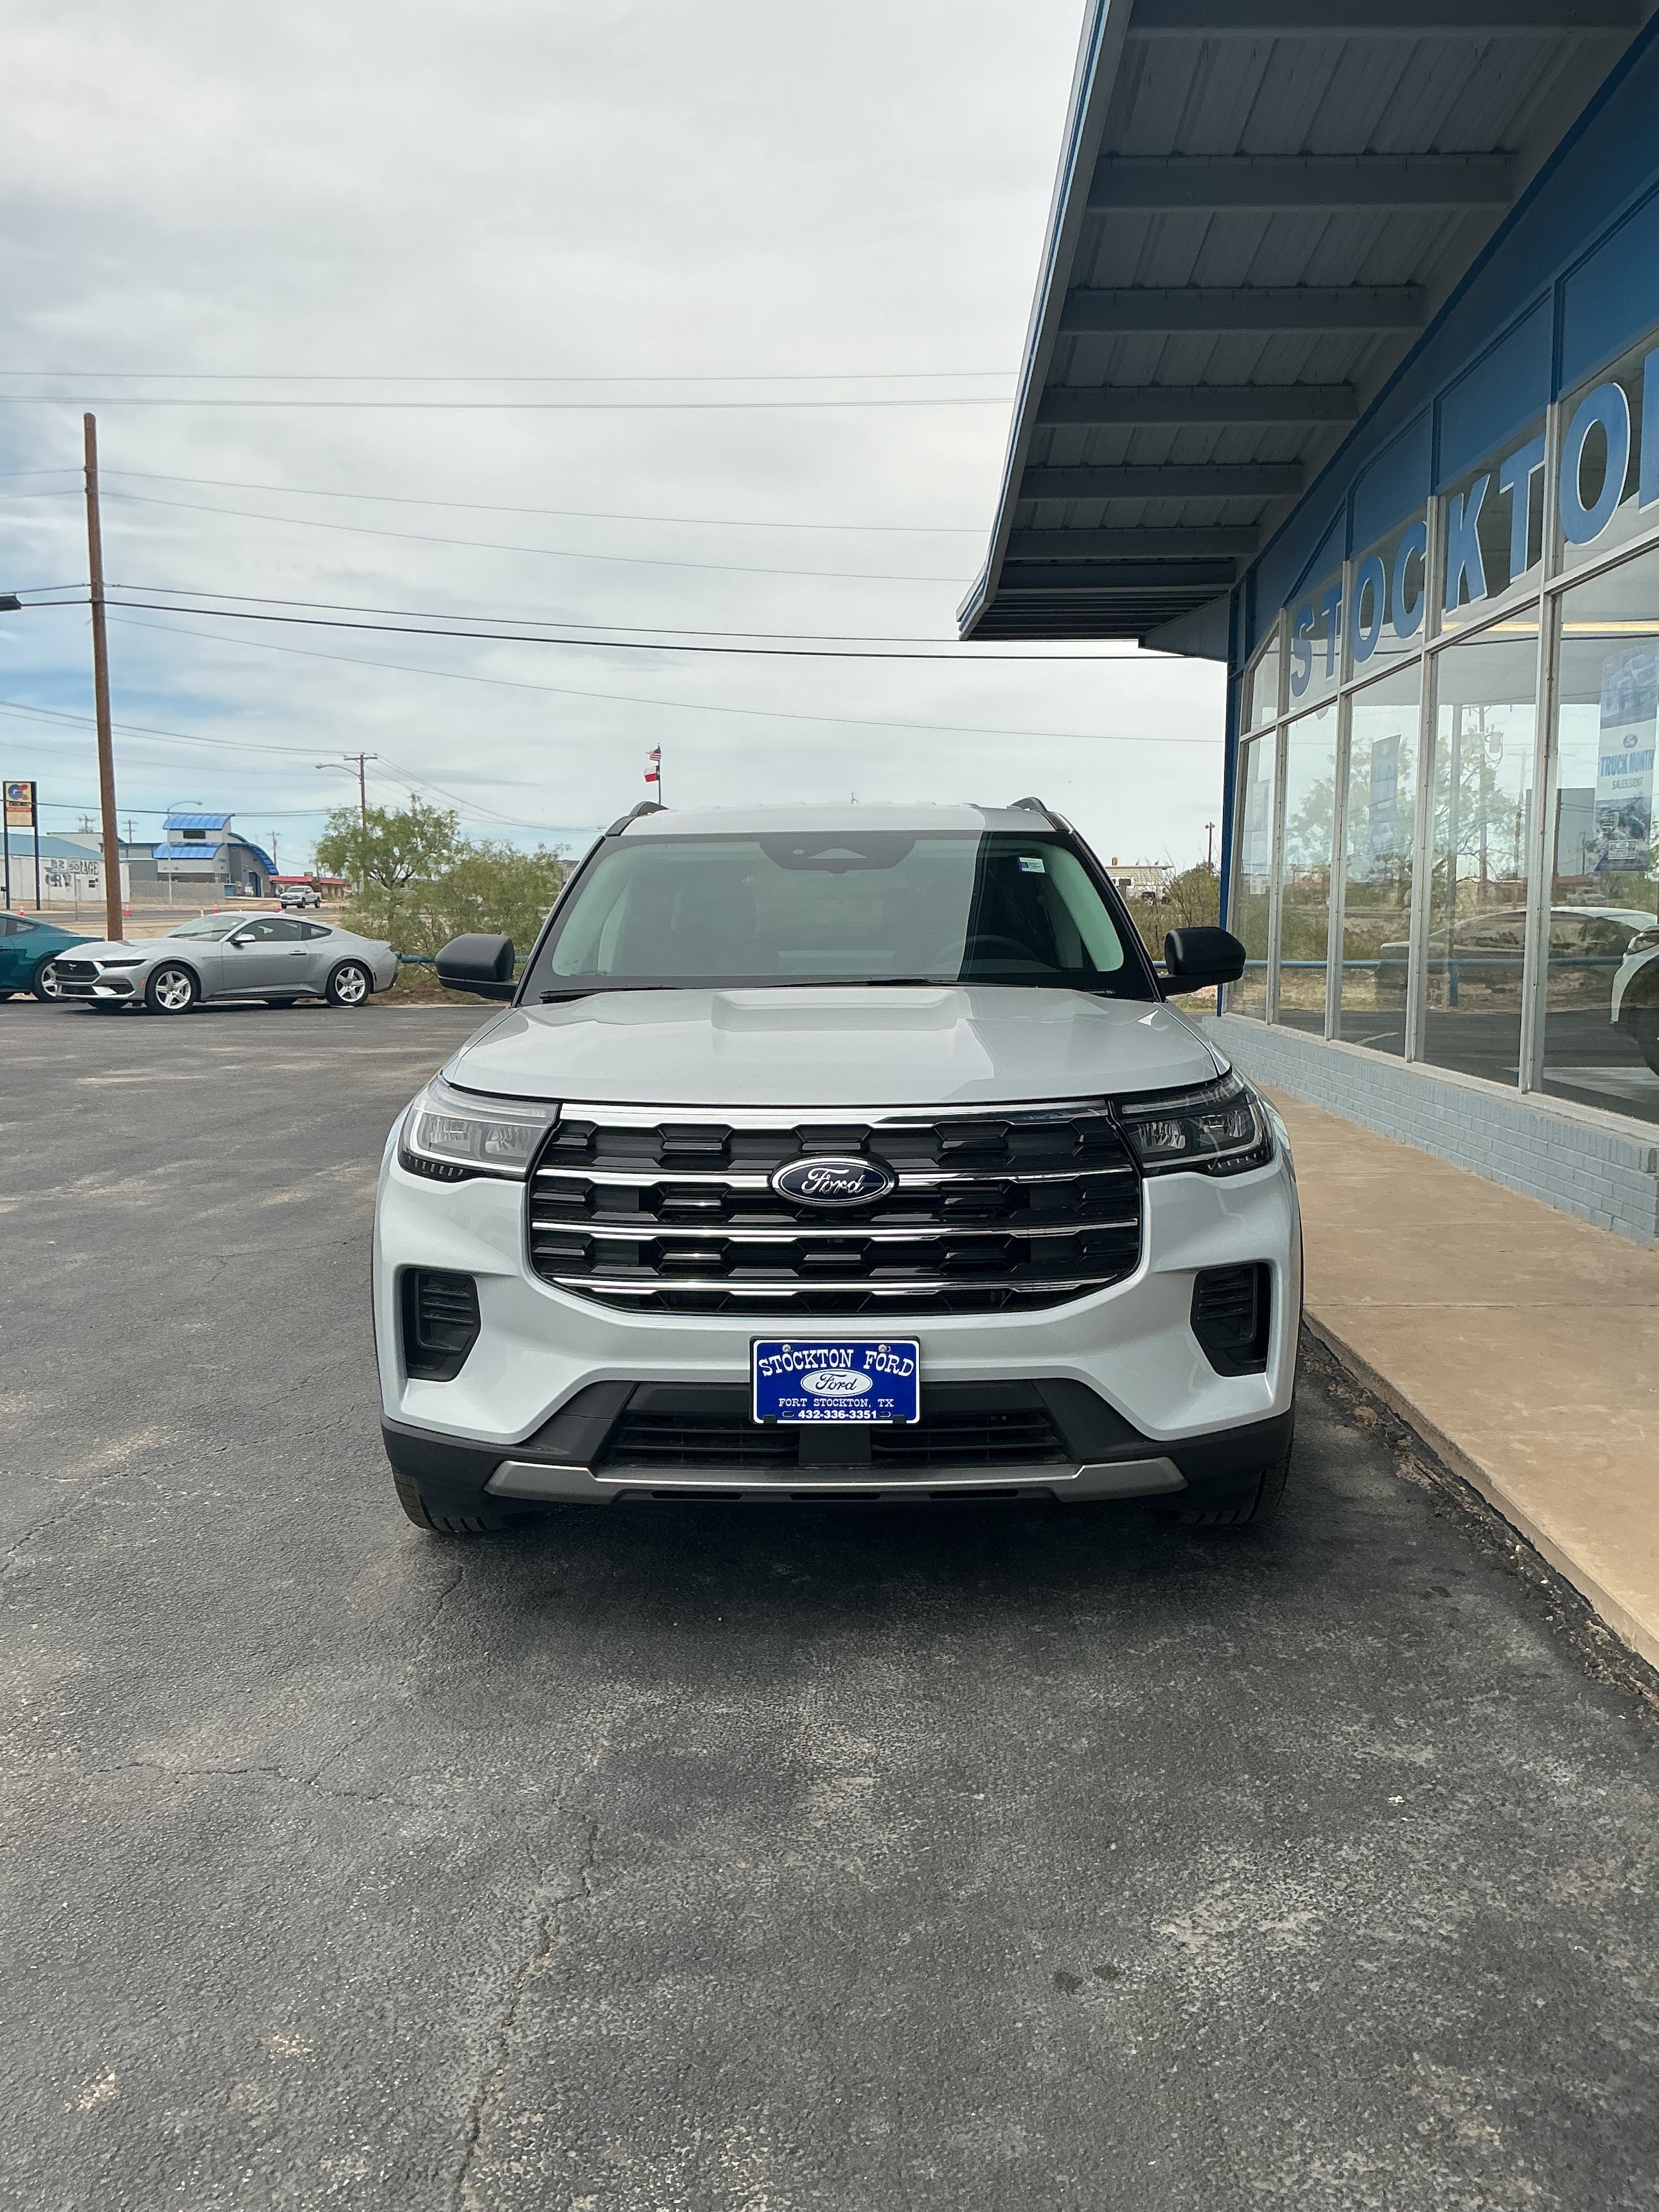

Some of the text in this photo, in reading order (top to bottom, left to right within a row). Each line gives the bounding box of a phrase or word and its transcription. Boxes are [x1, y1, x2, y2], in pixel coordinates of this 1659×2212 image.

[1290, 346, 1659, 698] STOCKTO
[1600, 753, 1628, 776] TRUCK
[801, 1167, 866, 1195] Ford
[758, 1349, 914, 1377] STOCKTON FORD
[815, 1373, 858, 1391] Ford
[778, 1398, 895, 1408] FORT STOCKTON, TX
[798, 1410, 877, 1419] 432-336-3351
